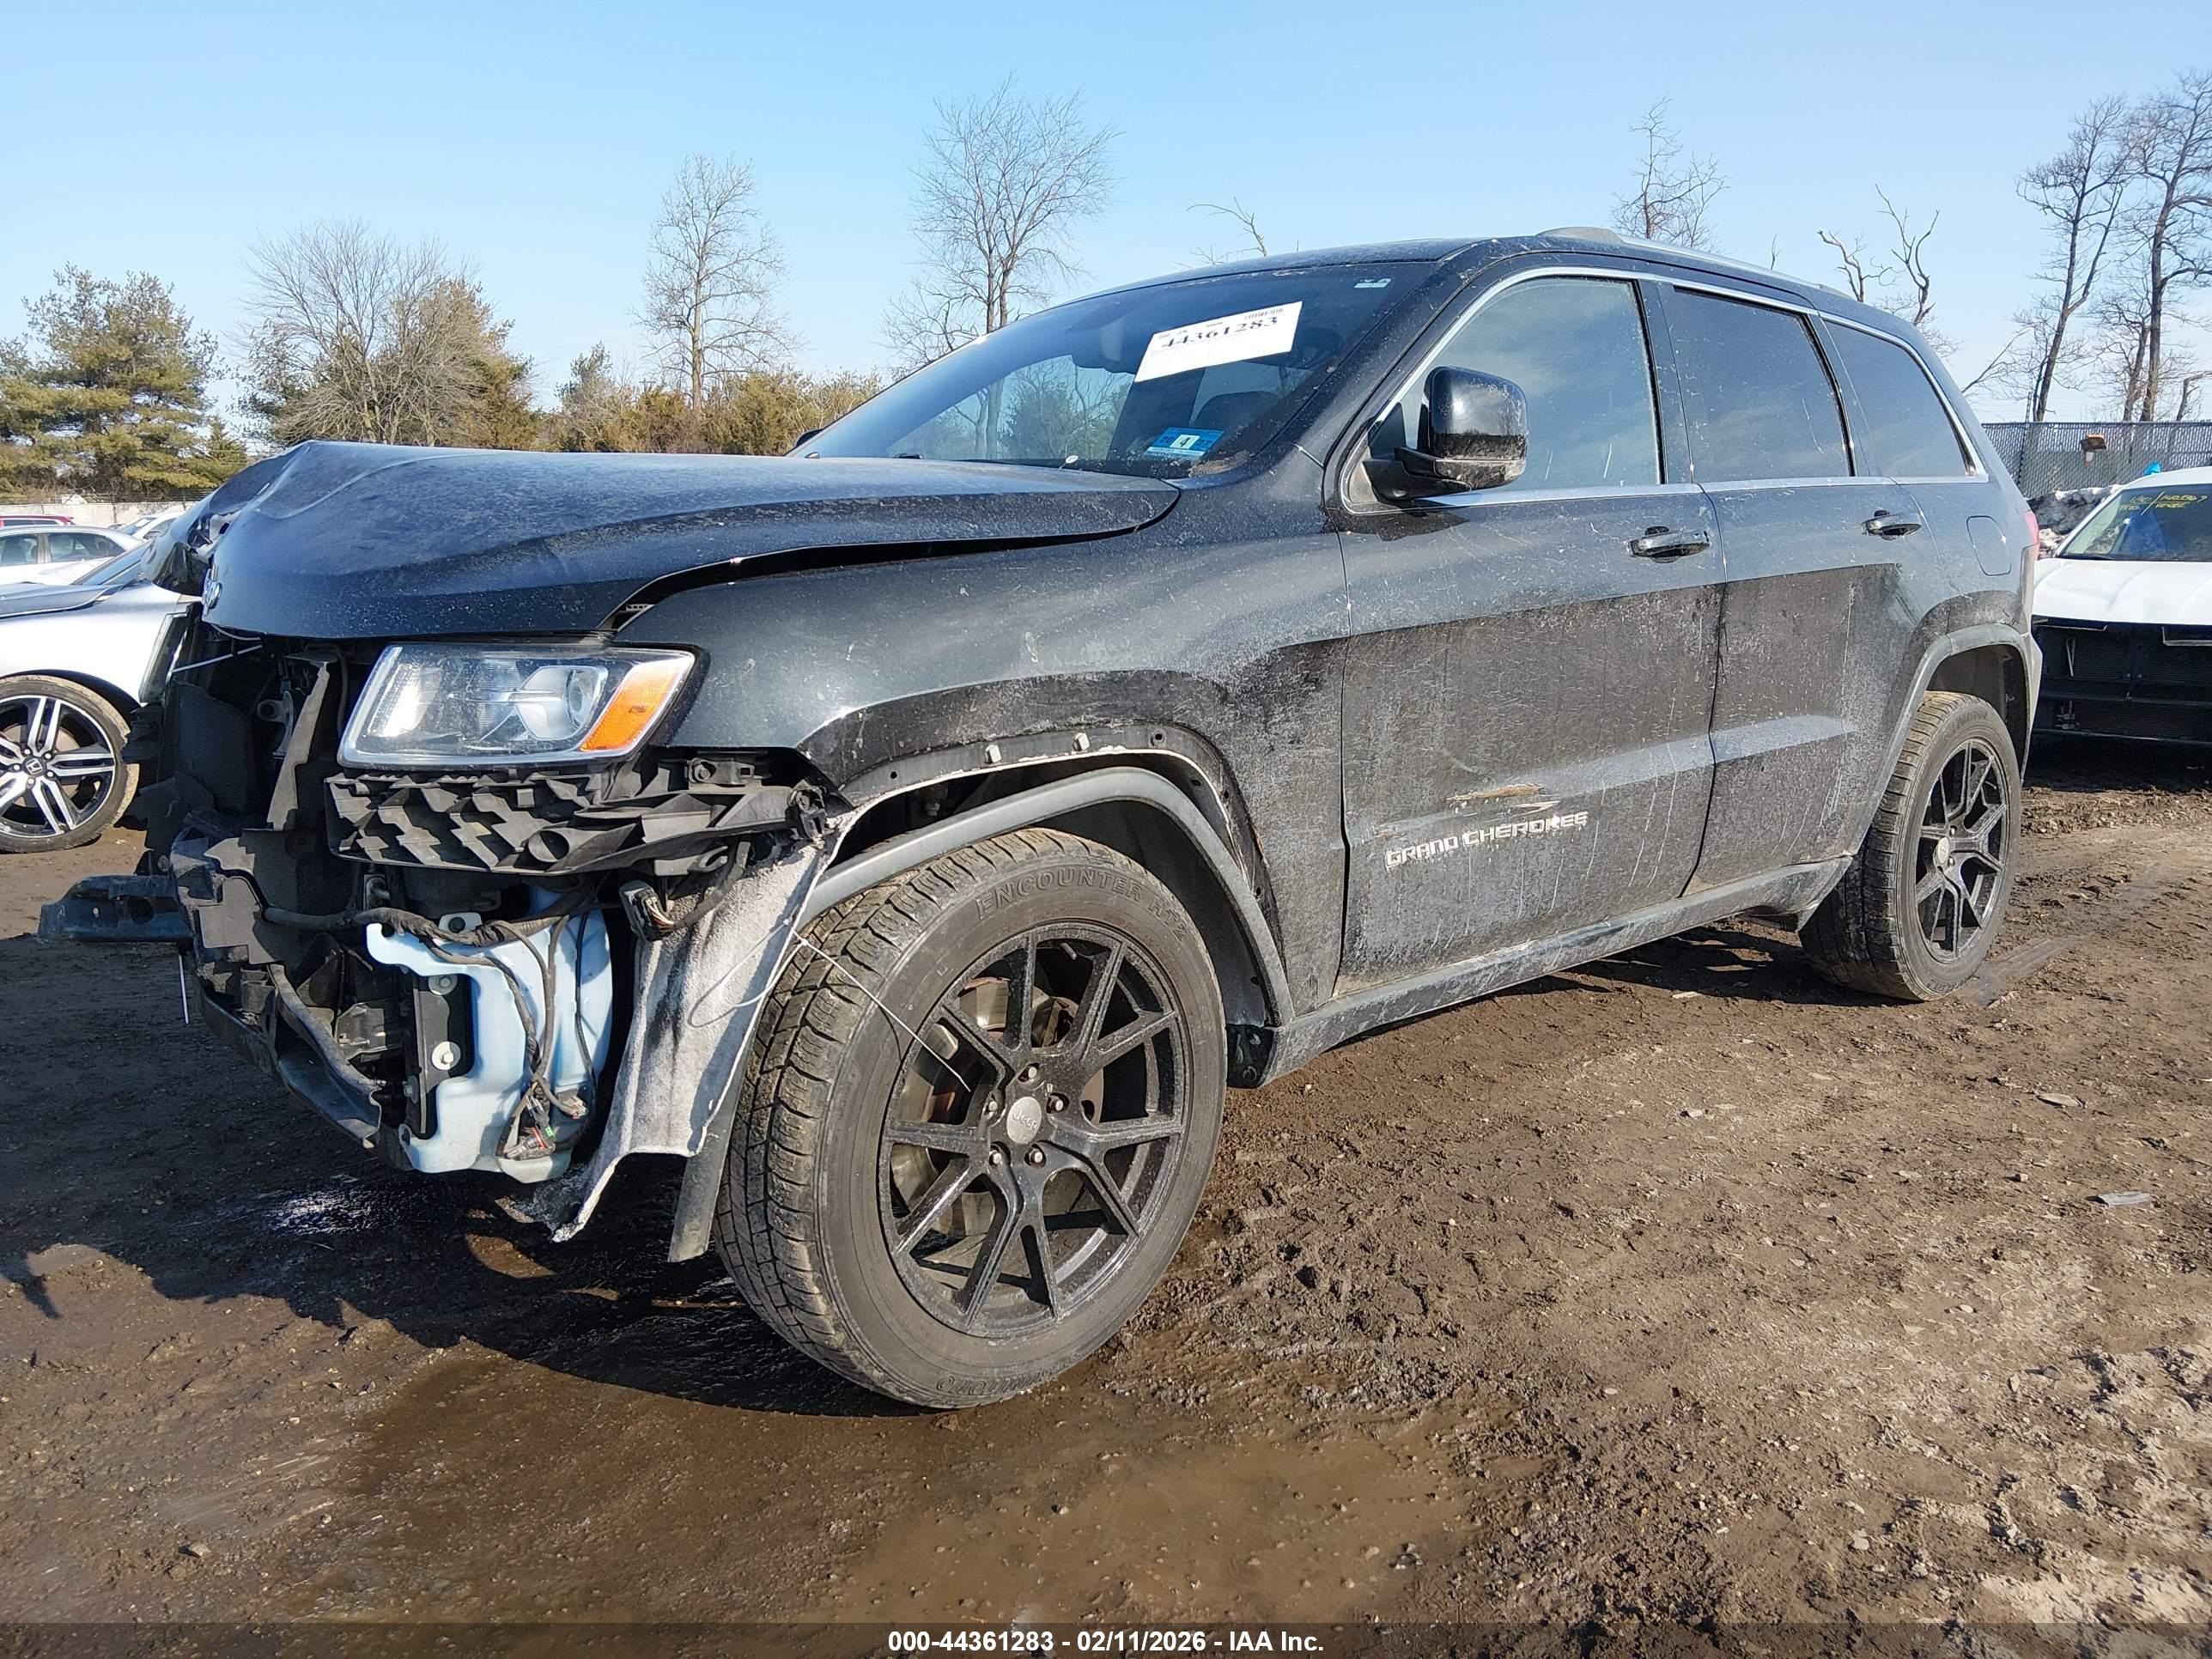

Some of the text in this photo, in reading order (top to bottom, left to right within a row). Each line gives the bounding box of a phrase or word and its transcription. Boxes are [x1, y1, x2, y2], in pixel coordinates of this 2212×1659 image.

[1161, 316, 1278, 348] 44361283
[1180, 436, 1191, 447] 4
[1385, 811, 1589, 868] GRAND CHEROKEE
[975, 866, 1143, 921] ENCOUNTER
